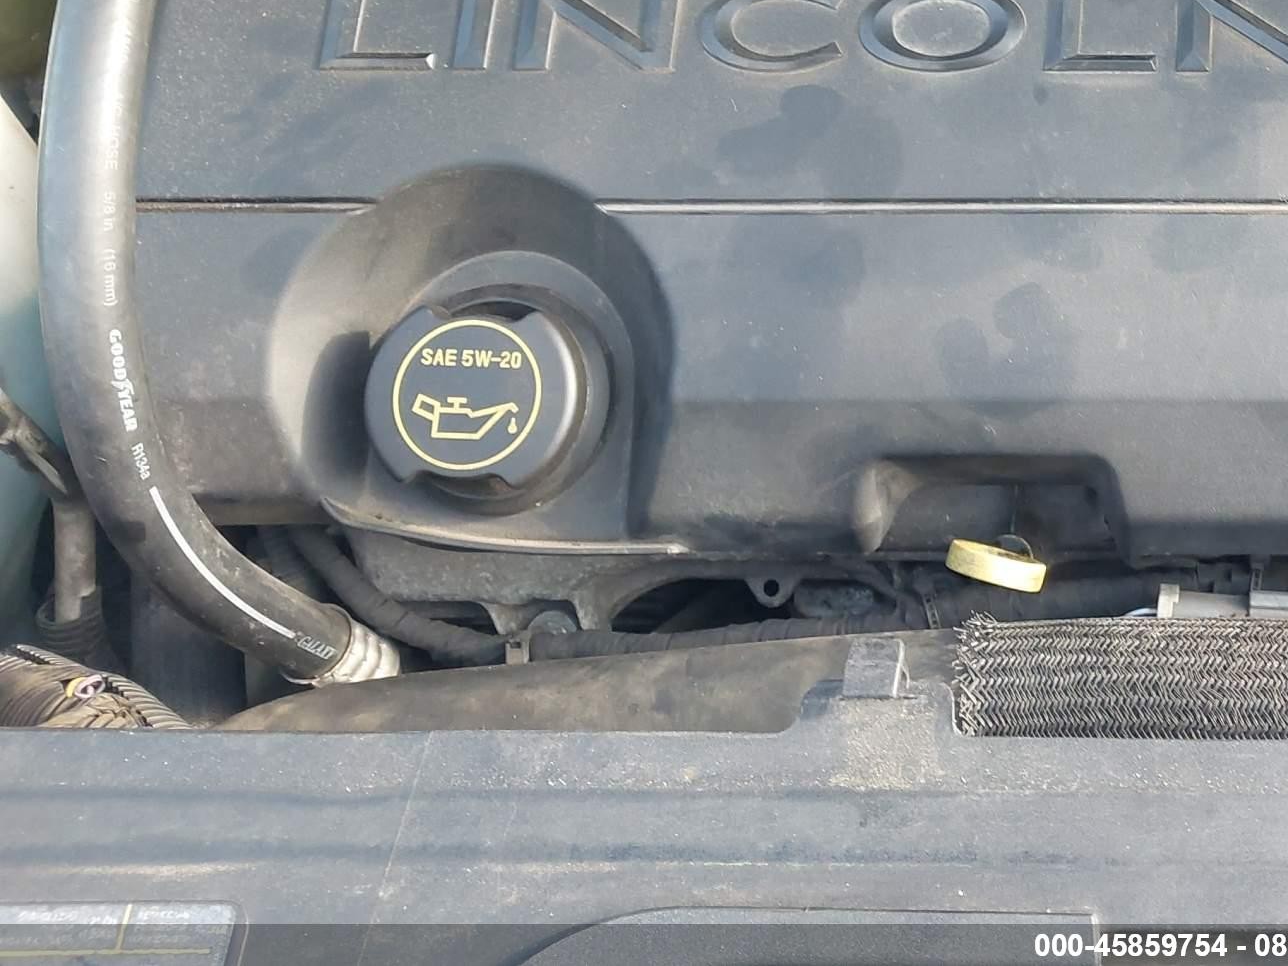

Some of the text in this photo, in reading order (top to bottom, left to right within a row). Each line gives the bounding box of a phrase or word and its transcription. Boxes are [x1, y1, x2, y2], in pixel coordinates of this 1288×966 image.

[105, 124, 121, 171] HOSE
[103, 191, 117, 214] 5/8
[103, 218, 115, 232] in
[103, 248, 117, 272] (16
[103, 274, 119, 307] mm)
[420, 347, 522, 370] SAE 5W-20
[109, 328, 138, 433] GOODYEAR
[130, 441, 151, 481] R134a
